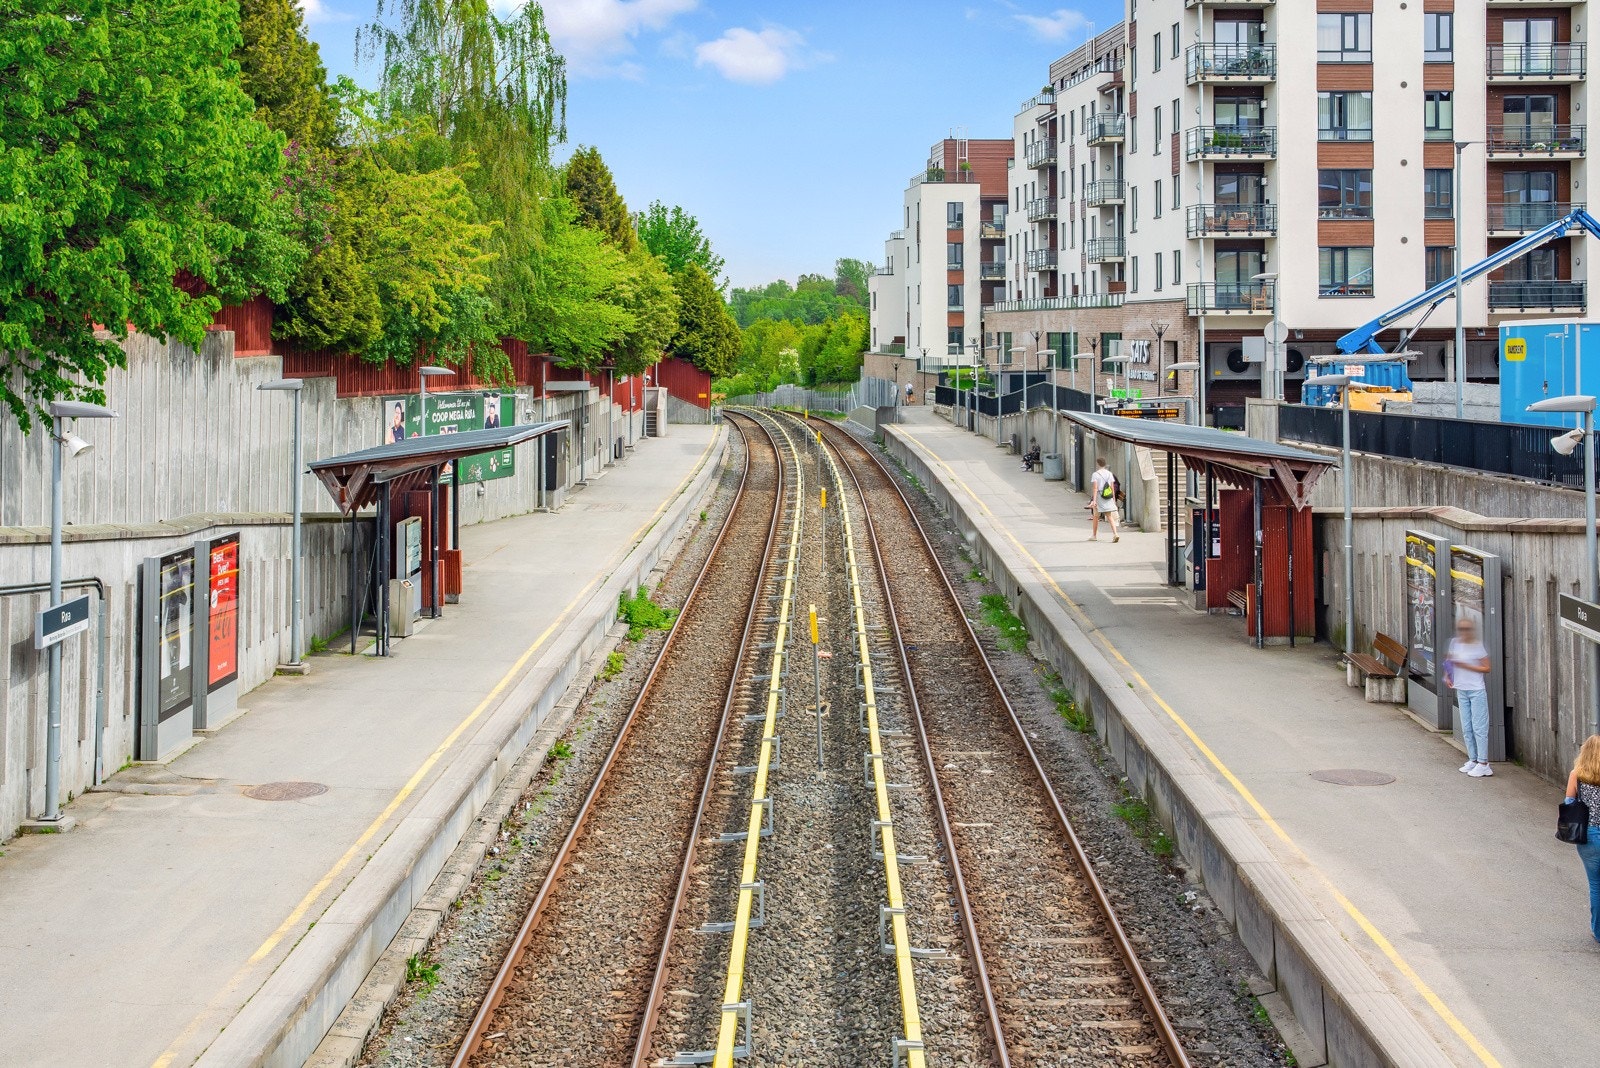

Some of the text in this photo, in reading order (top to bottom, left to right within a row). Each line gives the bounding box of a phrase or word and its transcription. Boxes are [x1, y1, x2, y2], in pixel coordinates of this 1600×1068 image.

[1130, 340, 1150, 364] SATS
[432, 411, 448, 423] COOP
[449, 410, 464, 421] MEGA
[213, 551, 224, 564] Best
[62, 611, 71, 623] Røa
[1578, 606, 1588, 622] Røa
